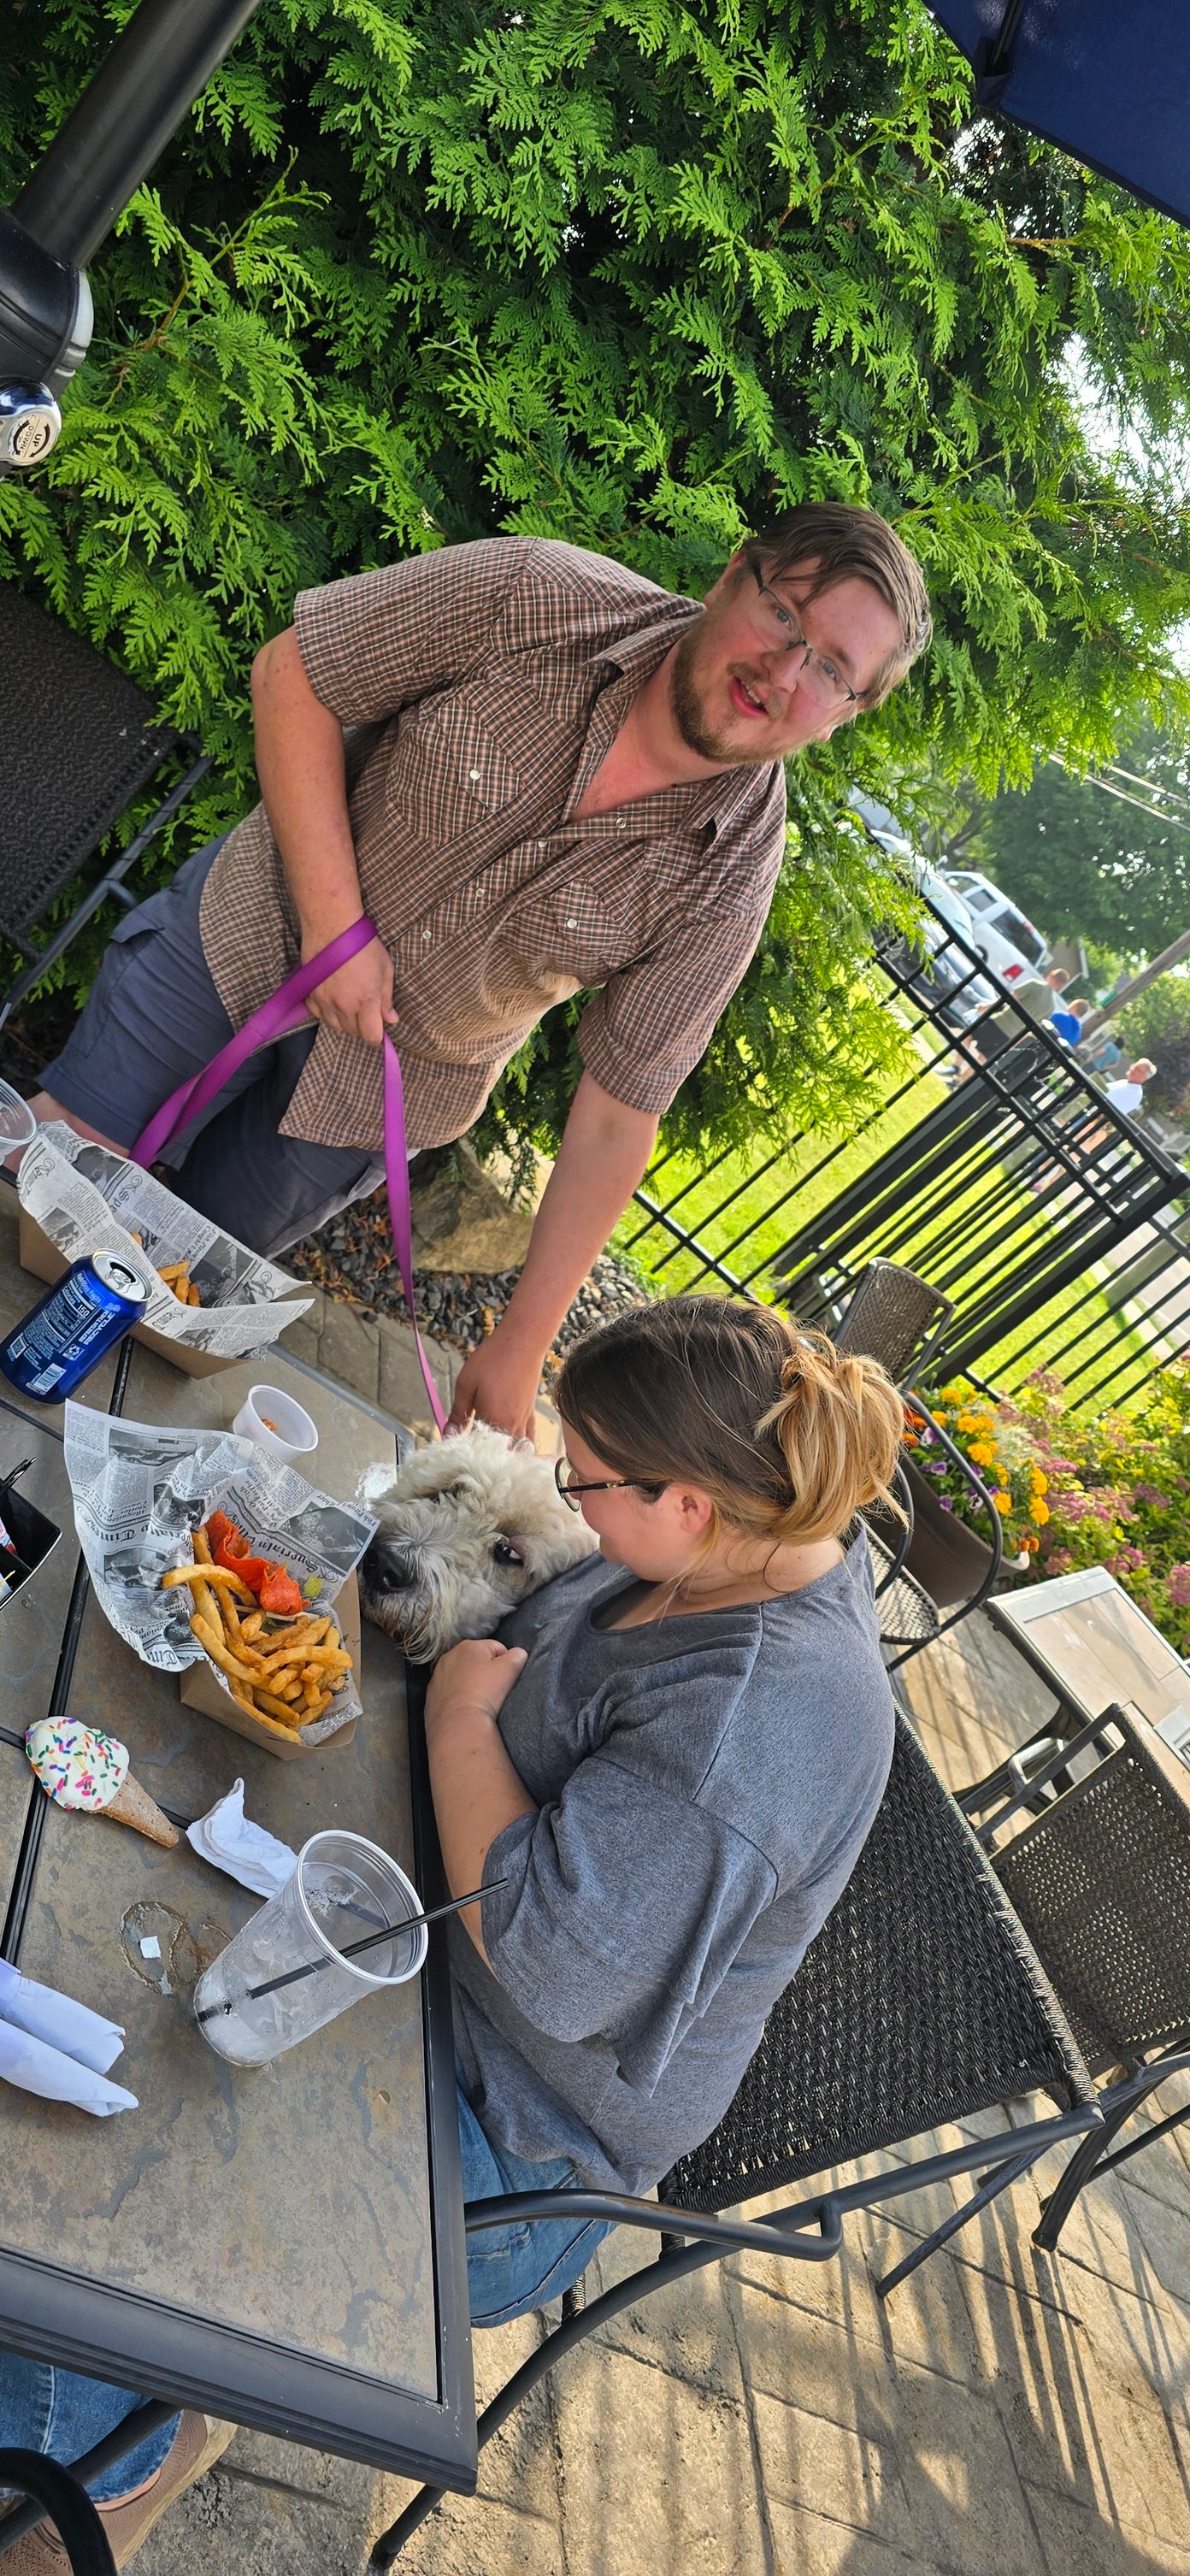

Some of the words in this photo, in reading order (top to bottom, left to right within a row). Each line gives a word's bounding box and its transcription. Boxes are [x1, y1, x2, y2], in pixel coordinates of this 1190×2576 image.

[33, 433, 43, 447] UP
[77, 1303, 90, 1317] 150
[83, 1311, 115, 1345] RECYCLE
[362, 1514, 376, 1526] Fish
